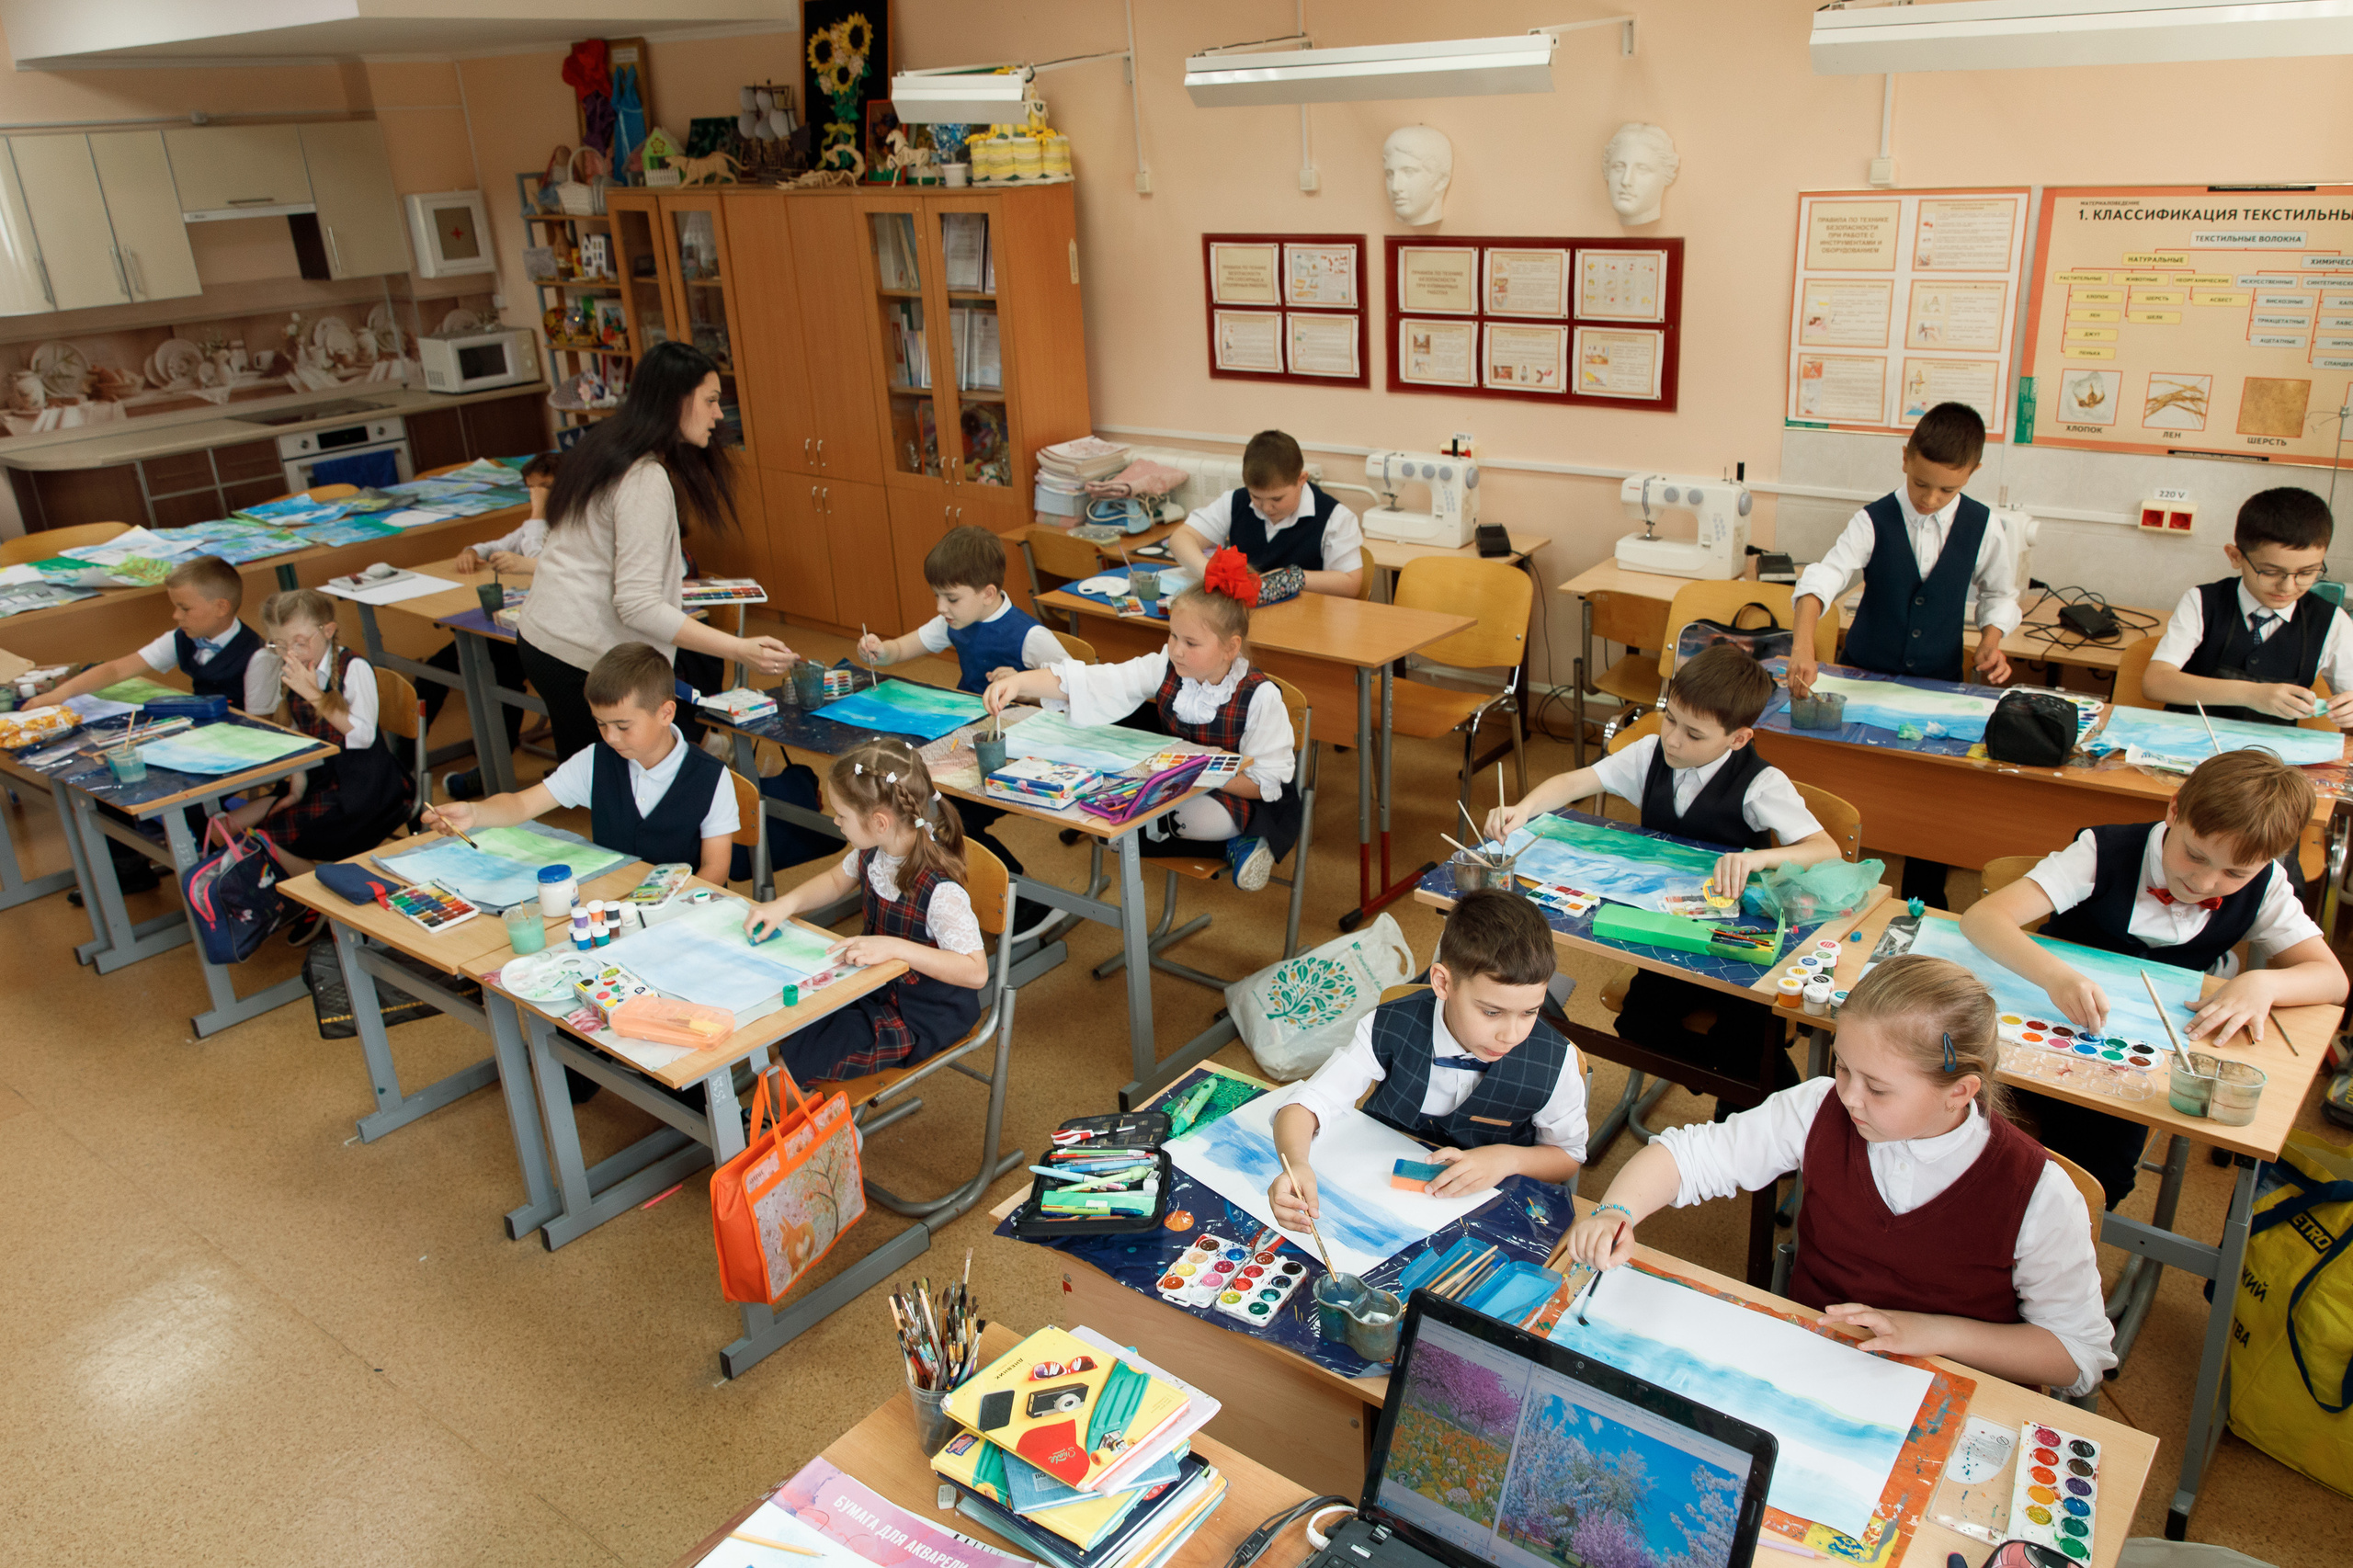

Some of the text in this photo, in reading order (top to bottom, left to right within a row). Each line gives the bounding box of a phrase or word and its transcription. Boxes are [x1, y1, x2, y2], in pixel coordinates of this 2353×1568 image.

[2079, 209, 2088, 221] 1.
[2093, 209, 2238, 222] КЛАССИФИКАЦИЯ
[2065, 424, 2103, 434] ХЛОПОК
[2162, 431, 2181, 439] ЛЕН
[2246, 437, 2287, 447] ШЕРСТЬ
[2159, 490, 2186, 499] 220 V
[1048, 1447, 1076, 1464] Skate
[834, 1494, 880, 1533] БУМАГА
[876, 1524, 908, 1548] ДЛЯ
